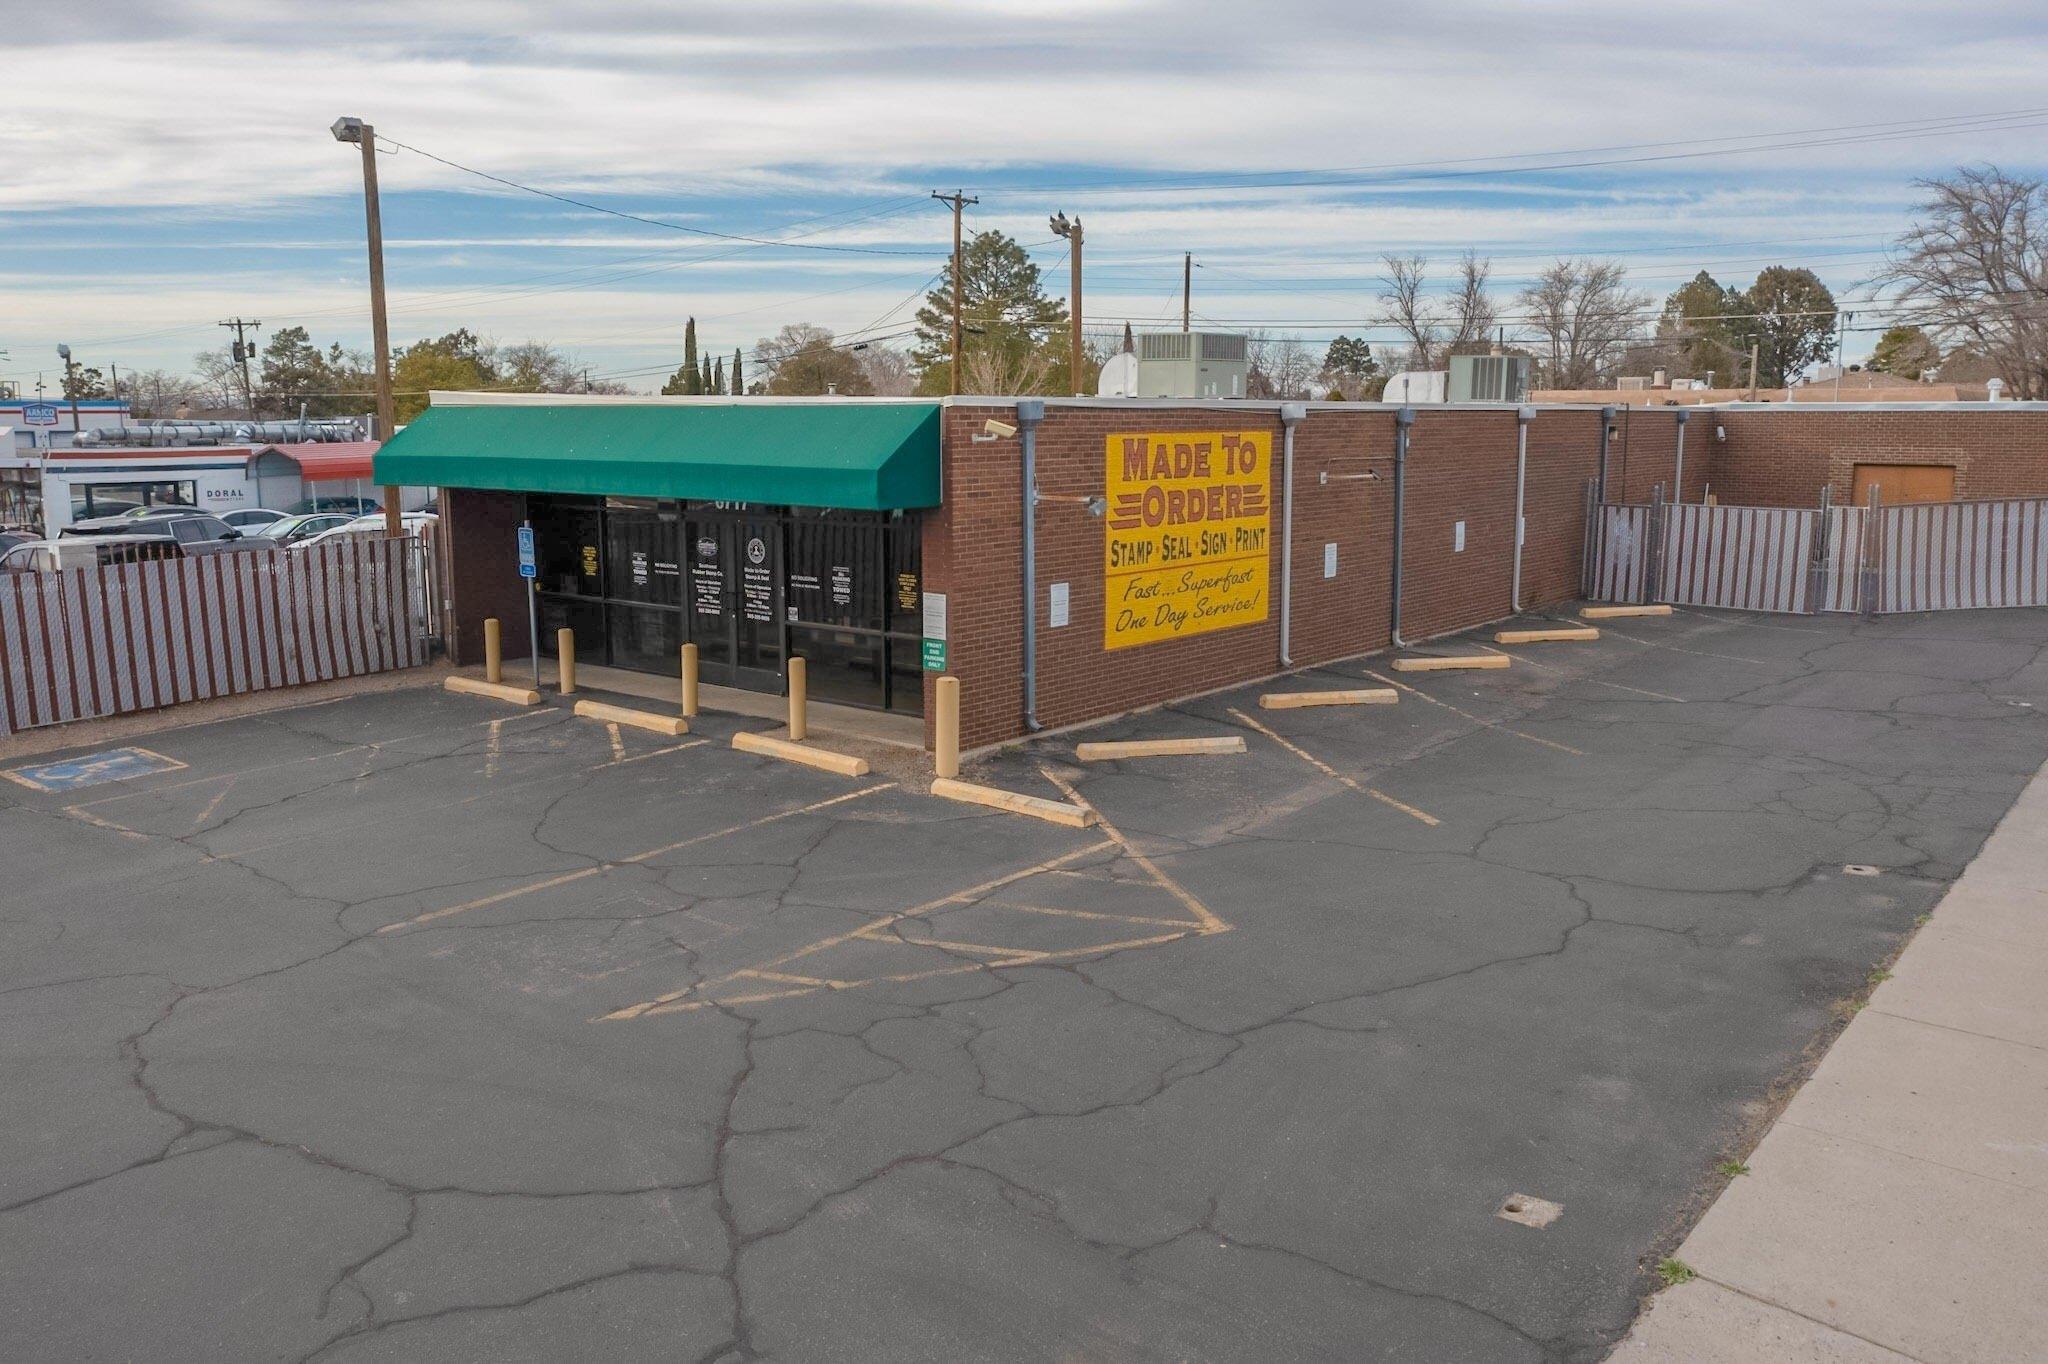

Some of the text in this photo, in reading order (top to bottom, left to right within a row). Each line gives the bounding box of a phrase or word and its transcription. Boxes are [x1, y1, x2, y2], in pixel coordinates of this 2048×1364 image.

[1122, 434, 1257, 482] MADE TO
[1142, 484, 1243, 528] ORDER
[1111, 527, 1266, 568] STAMP SEAL SIGN PRINT
[1177, 566, 1254, 599] Superfast
[1115, 590, 1261, 633] One Day Service!
